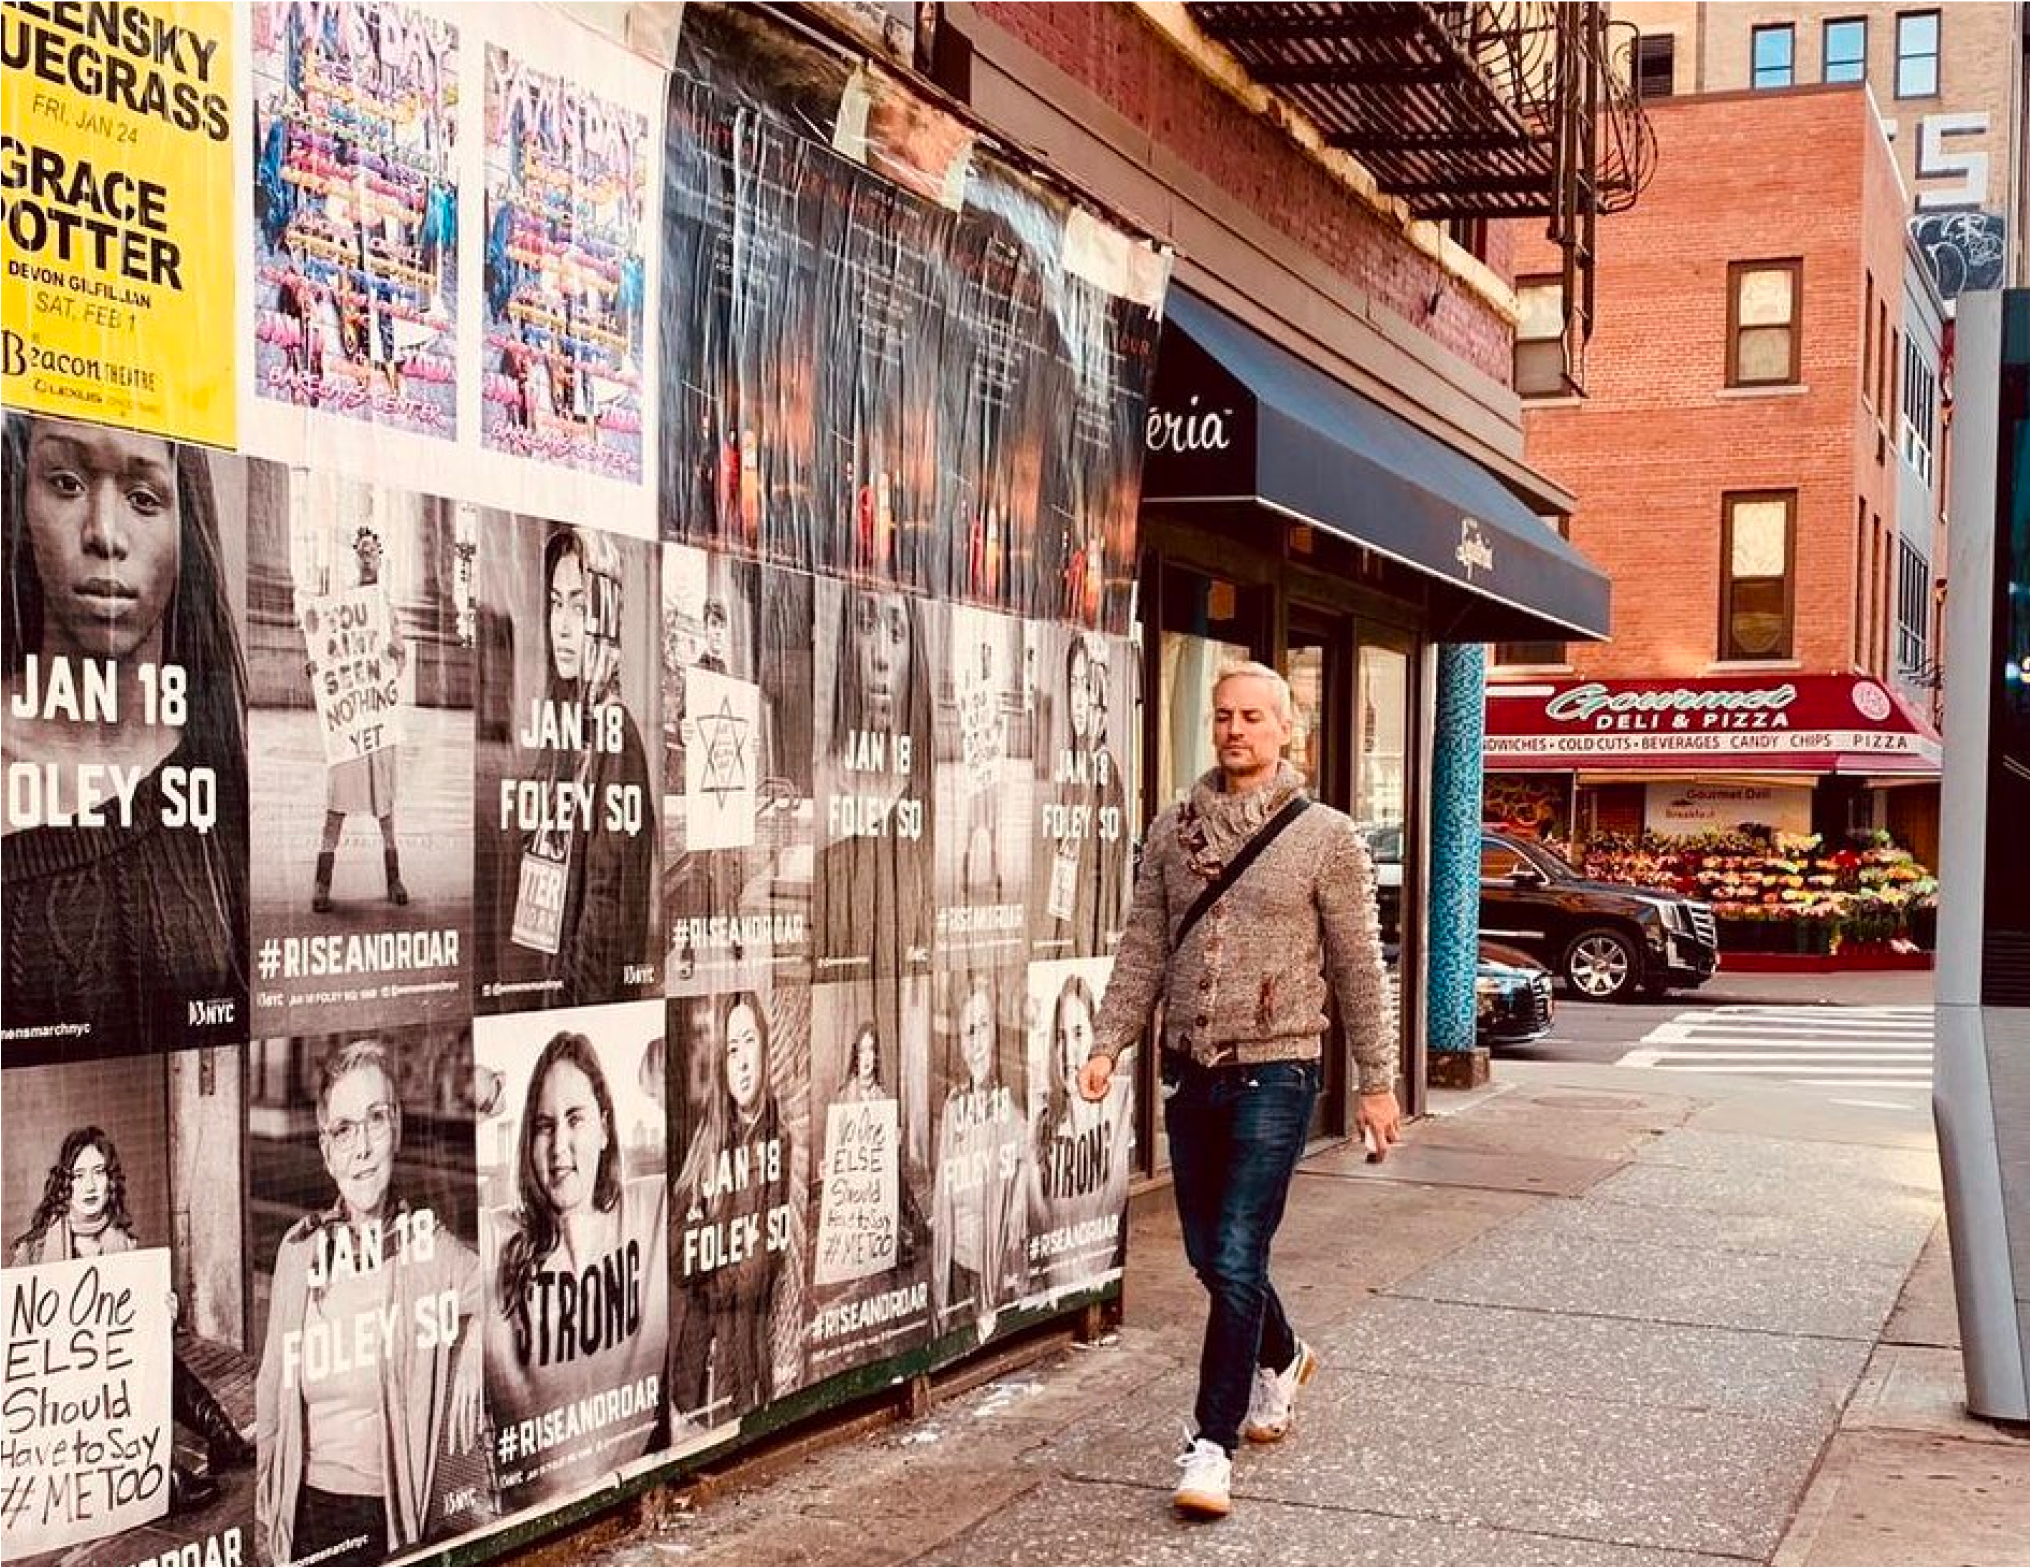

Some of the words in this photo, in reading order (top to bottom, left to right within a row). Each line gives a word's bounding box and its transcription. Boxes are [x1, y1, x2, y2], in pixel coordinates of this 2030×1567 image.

[76, 110, 113, 138] JAN
[117, 122, 138, 143] 24
[0, 136, 167, 233] GRACE
[0, 197, 182, 290] OTTER
[9, 260, 63, 286] DEVON
[85, 301, 121, 328] FEB
[12, 654, 117, 724] JAN
[138, 663, 187, 725] 18
[327, 680, 397, 731] NOTHING
[350, 724, 384, 752] YET
[521, 699, 582, 750] JAN
[594, 705, 623, 753] 18
[1484, 738, 1546, 752] DWICHES
[1558, 737, 1593, 751] COLD
[1598, 737, 1631, 751] CUTS
[1642, 736, 1720, 750] BEVERAGES
[1730, 735, 1779, 749] CANDY
[1790, 734, 1832, 748] CHIPS
[1854, 735, 1907, 748] PIZZA
[1597, 714, 1659, 730] DELI
[1671, 714, 1690, 729] &
[1702, 711, 1789, 728] PIZZA
[845, 730, 885, 772] JAN
[9, 763, 141, 827] OLEY
[161, 766, 216, 833] SQ
[500, 779, 595, 831] FOLEY
[607, 785, 641, 836] SQ
[829, 794, 893, 836] FOLEY
[899, 799, 921, 842] SQ
[1042, 804, 1090, 838] FOLEY
[258, 929, 459, 980] #RISEANDROAR
[701, 1144, 749, 1198] JAN
[757, 1139, 781, 1185] 18
[833, 1146, 883, 1174] ELSE
[1042, 1120, 1111, 1198] STRONG
[308, 1219, 382, 1287] JAN
[395, 1209, 434, 1265] 18
[684, 1213, 760, 1276] FOLEY
[12, 1275, 59, 1337] No
[70, 1266, 135, 1327] One
[516, 1239, 640, 1367] STRONG
[5, 1328, 134, 1383] ELSE
[284, 1303, 398, 1388] FOLEY
[416, 1290, 459, 1348] SQ
[2, 1378, 131, 1434] Should
[498, 1375, 659, 1465] #RISEANDROAR
[0, 1437, 68, 1469] Have
[73, 1429, 104, 1465] to
[107, 1426, 160, 1467] Say
